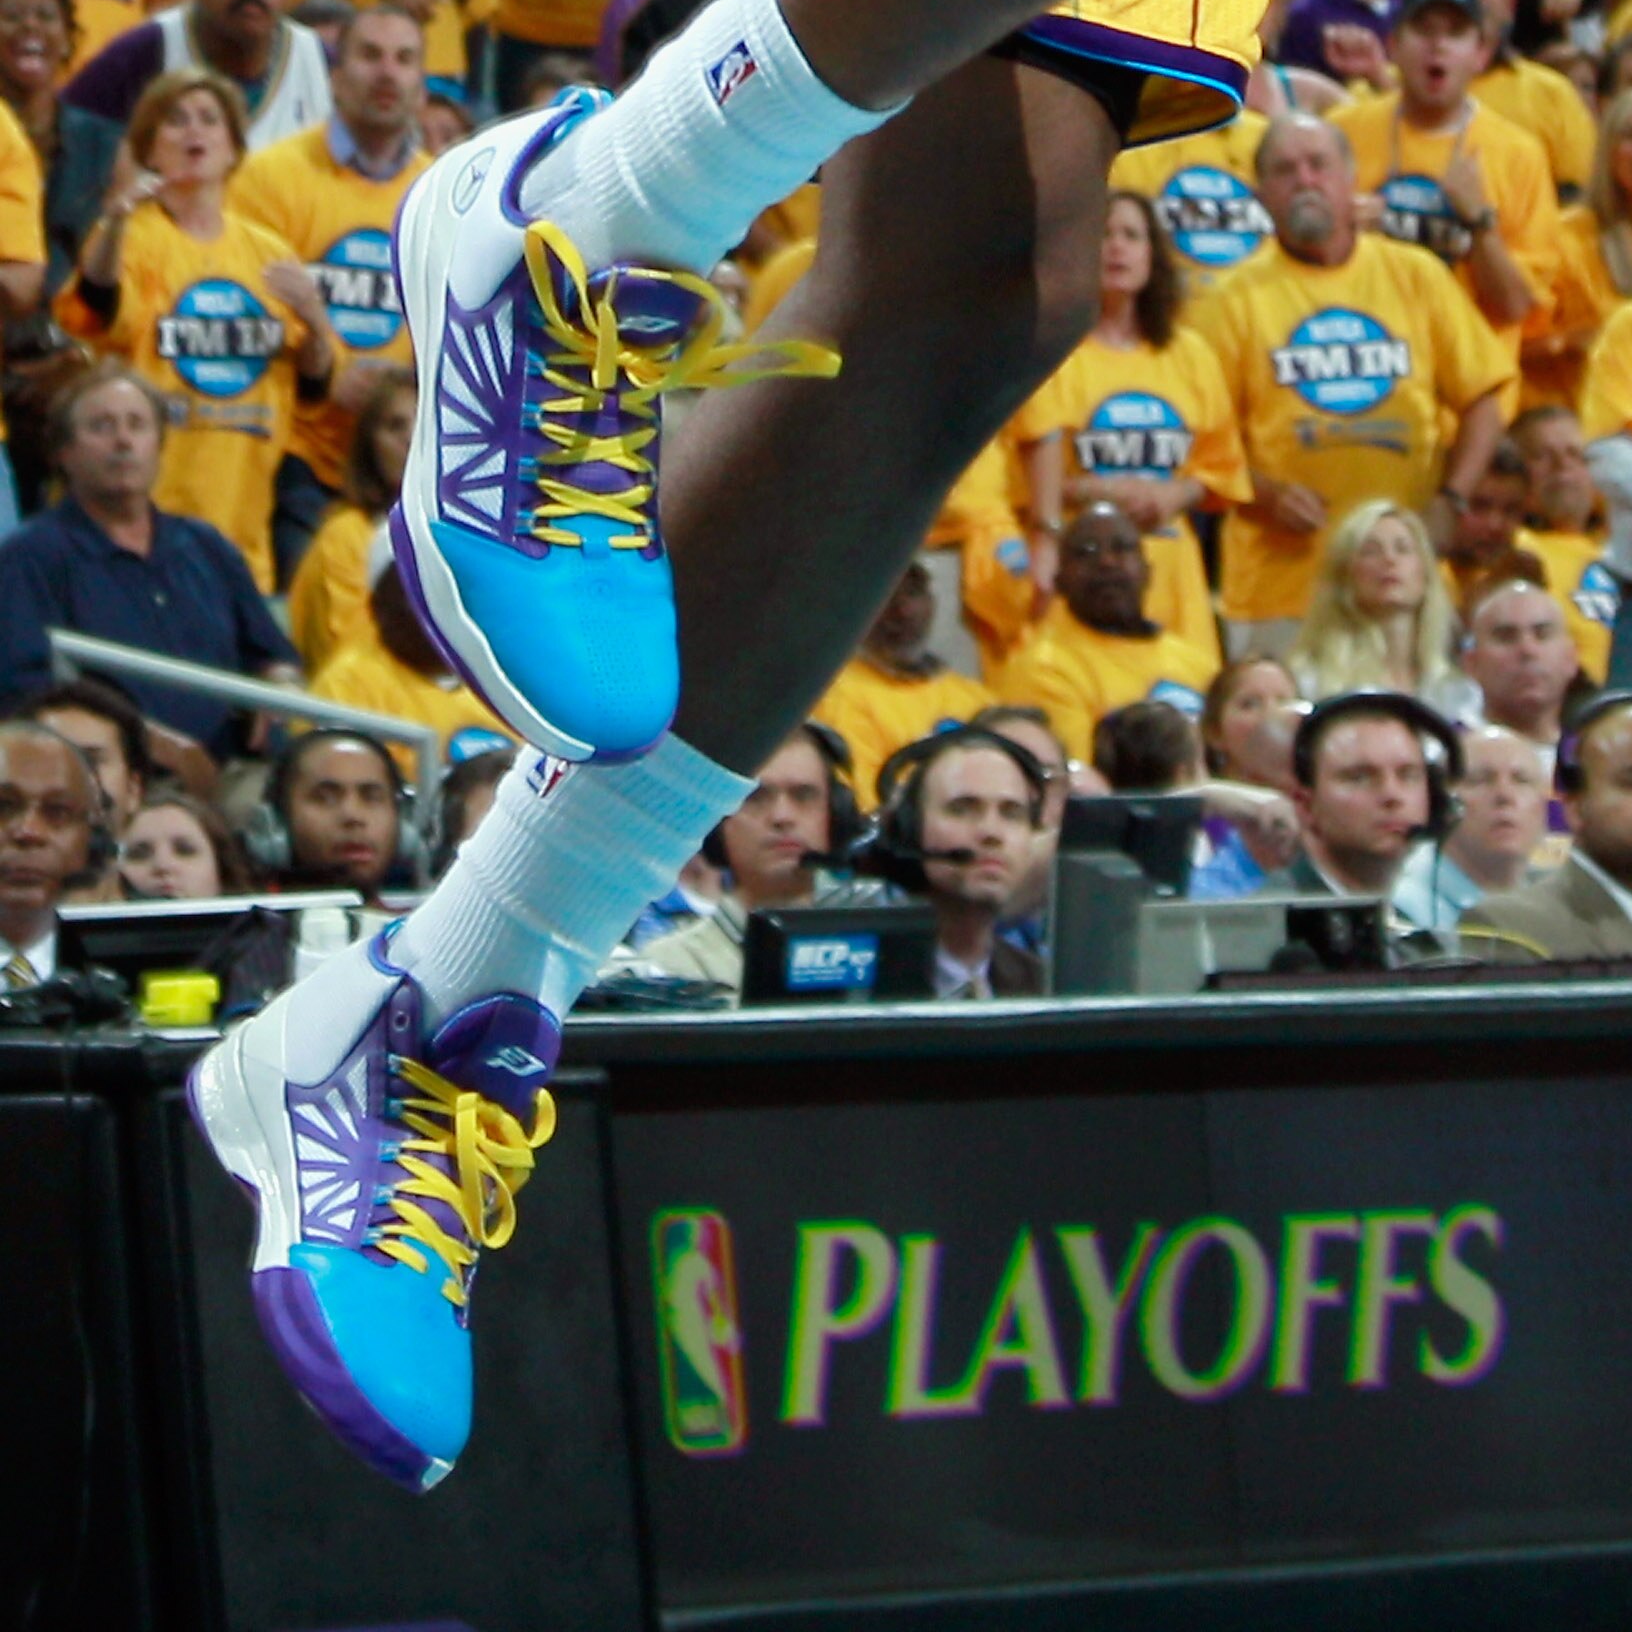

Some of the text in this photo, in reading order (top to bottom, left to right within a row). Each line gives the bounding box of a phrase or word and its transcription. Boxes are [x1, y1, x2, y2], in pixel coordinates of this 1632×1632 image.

[158, 314, 227, 359] I'M
[1272, 339, 1411, 386] I'M IN
[1075, 430, 1143, 470] I'M
[780, 1201, 1507, 1429] PLAYOFFS
